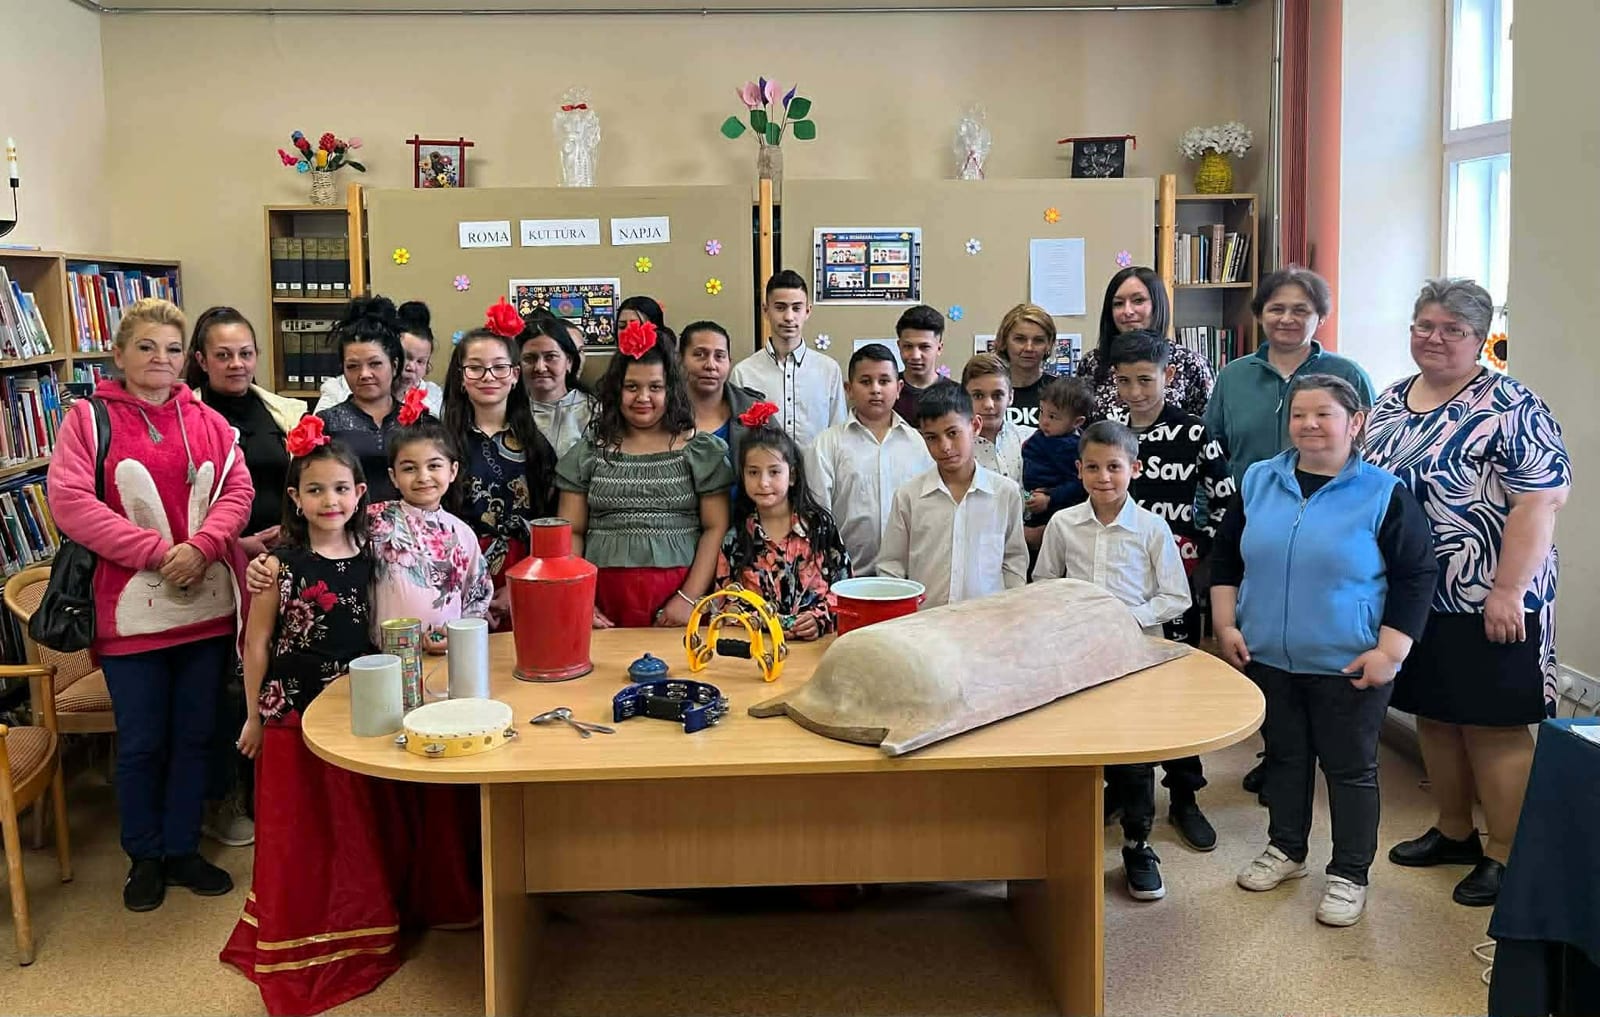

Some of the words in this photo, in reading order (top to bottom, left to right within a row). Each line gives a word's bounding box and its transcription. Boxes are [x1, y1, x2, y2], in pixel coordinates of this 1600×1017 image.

[468, 231, 509, 243] ROMA
[528, 227, 586, 240] KULTÚRA
[619, 227, 662, 240] NAPJA
